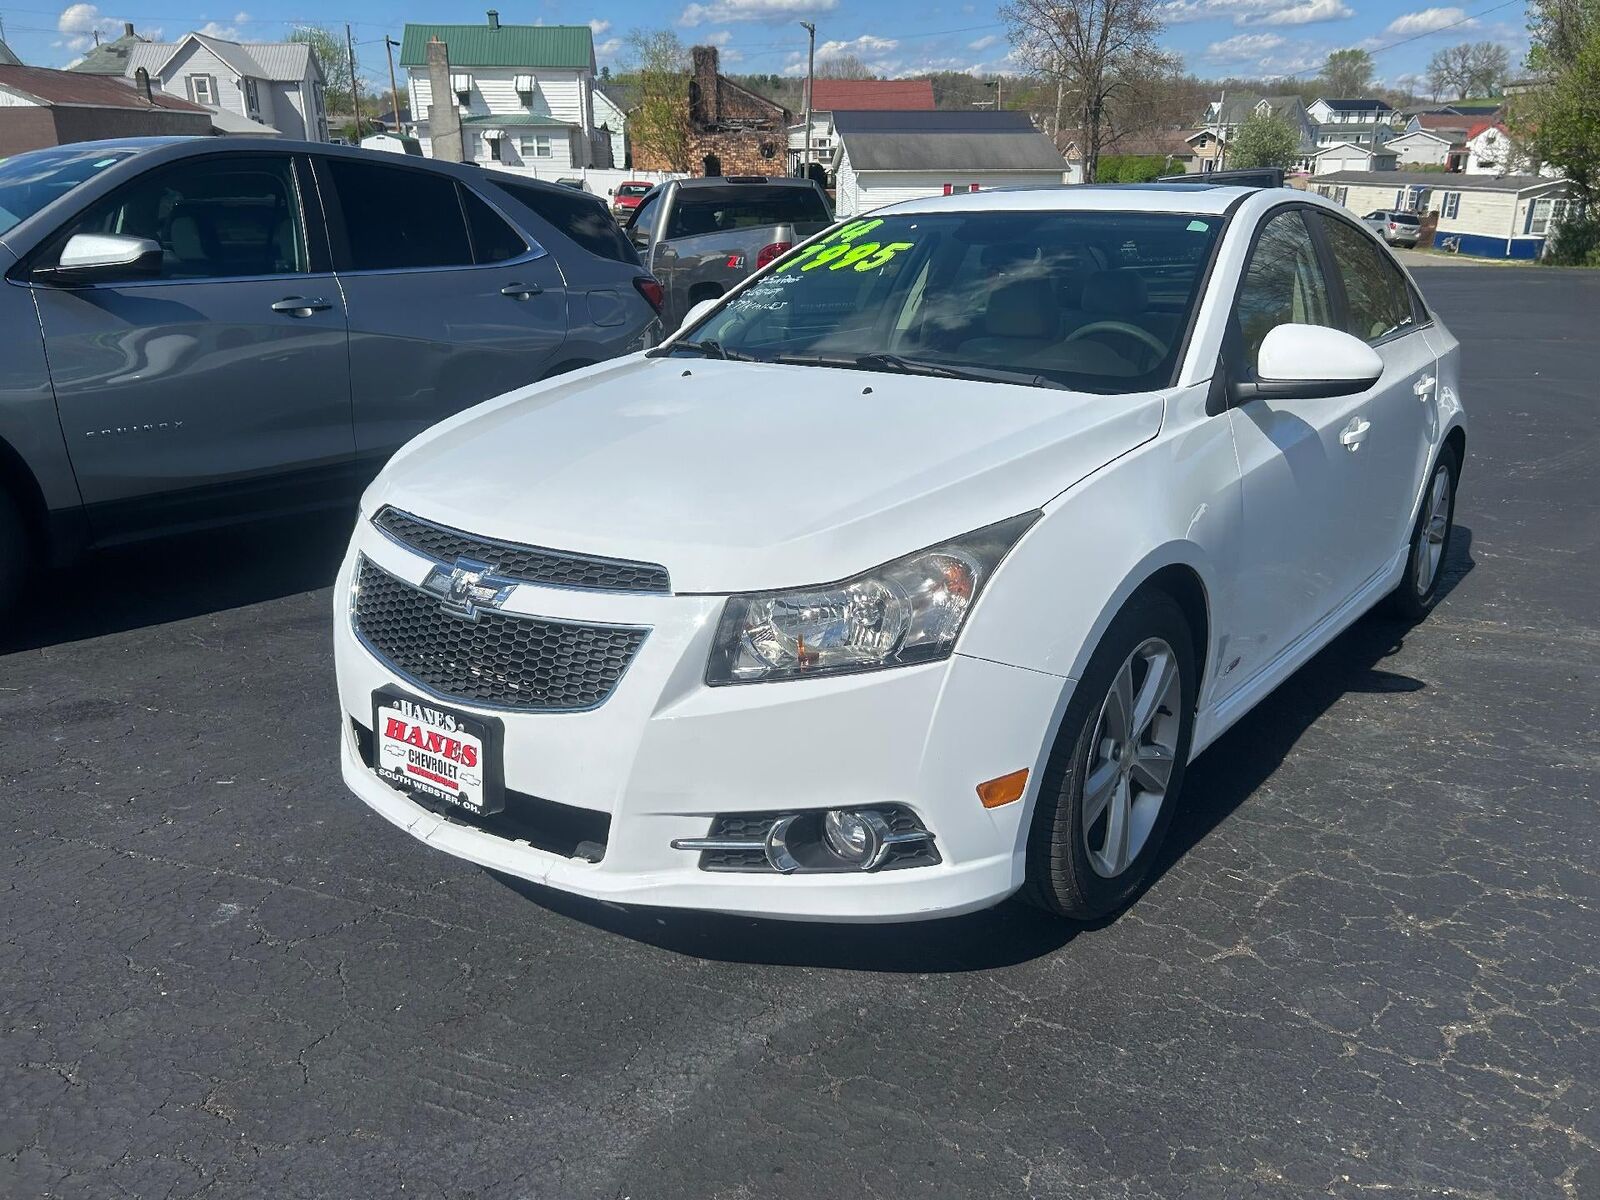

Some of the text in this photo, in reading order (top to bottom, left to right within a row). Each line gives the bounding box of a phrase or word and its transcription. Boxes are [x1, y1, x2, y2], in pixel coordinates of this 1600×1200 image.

[776, 242, 915, 273] 7995
[400, 699, 457, 733] HANES
[384, 717, 478, 768] HANES
[378, 768, 412, 786] SOUTH
[408, 749, 459, 780] CHEVROLET
